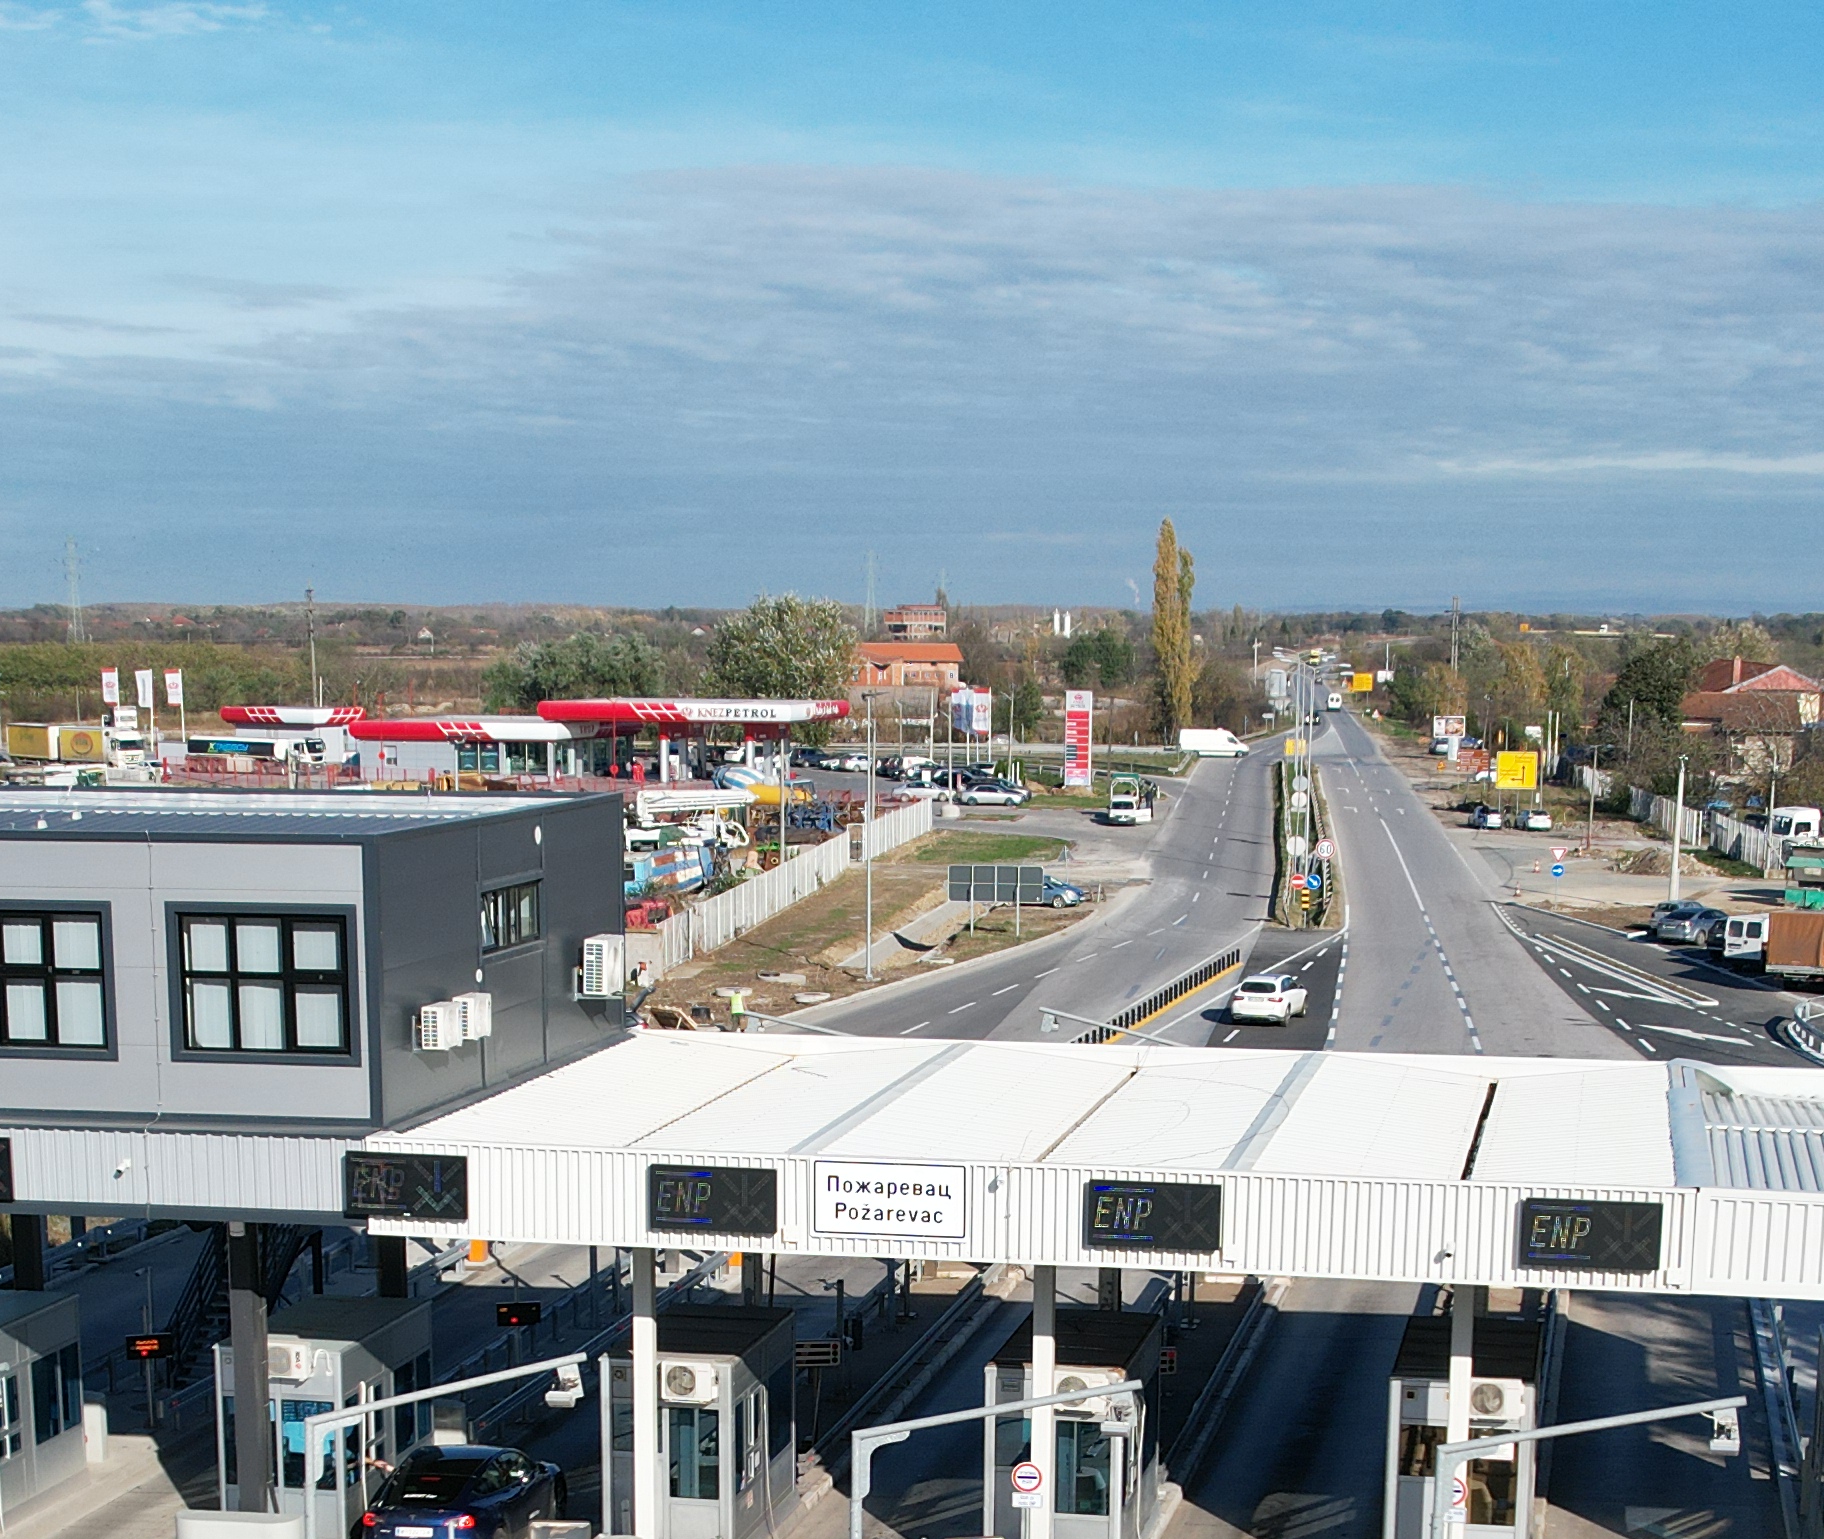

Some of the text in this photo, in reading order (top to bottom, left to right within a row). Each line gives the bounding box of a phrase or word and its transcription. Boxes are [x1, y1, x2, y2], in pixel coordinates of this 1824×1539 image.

[1319, 844, 1332, 855] 60
[657, 1181, 711, 1213] ENP
[827, 1174, 952, 1200] Пожаревац
[835, 1201, 944, 1224] Požarevac
[1094, 1196, 1153, 1230] ENP
[1529, 1215, 1592, 1249] ENP
